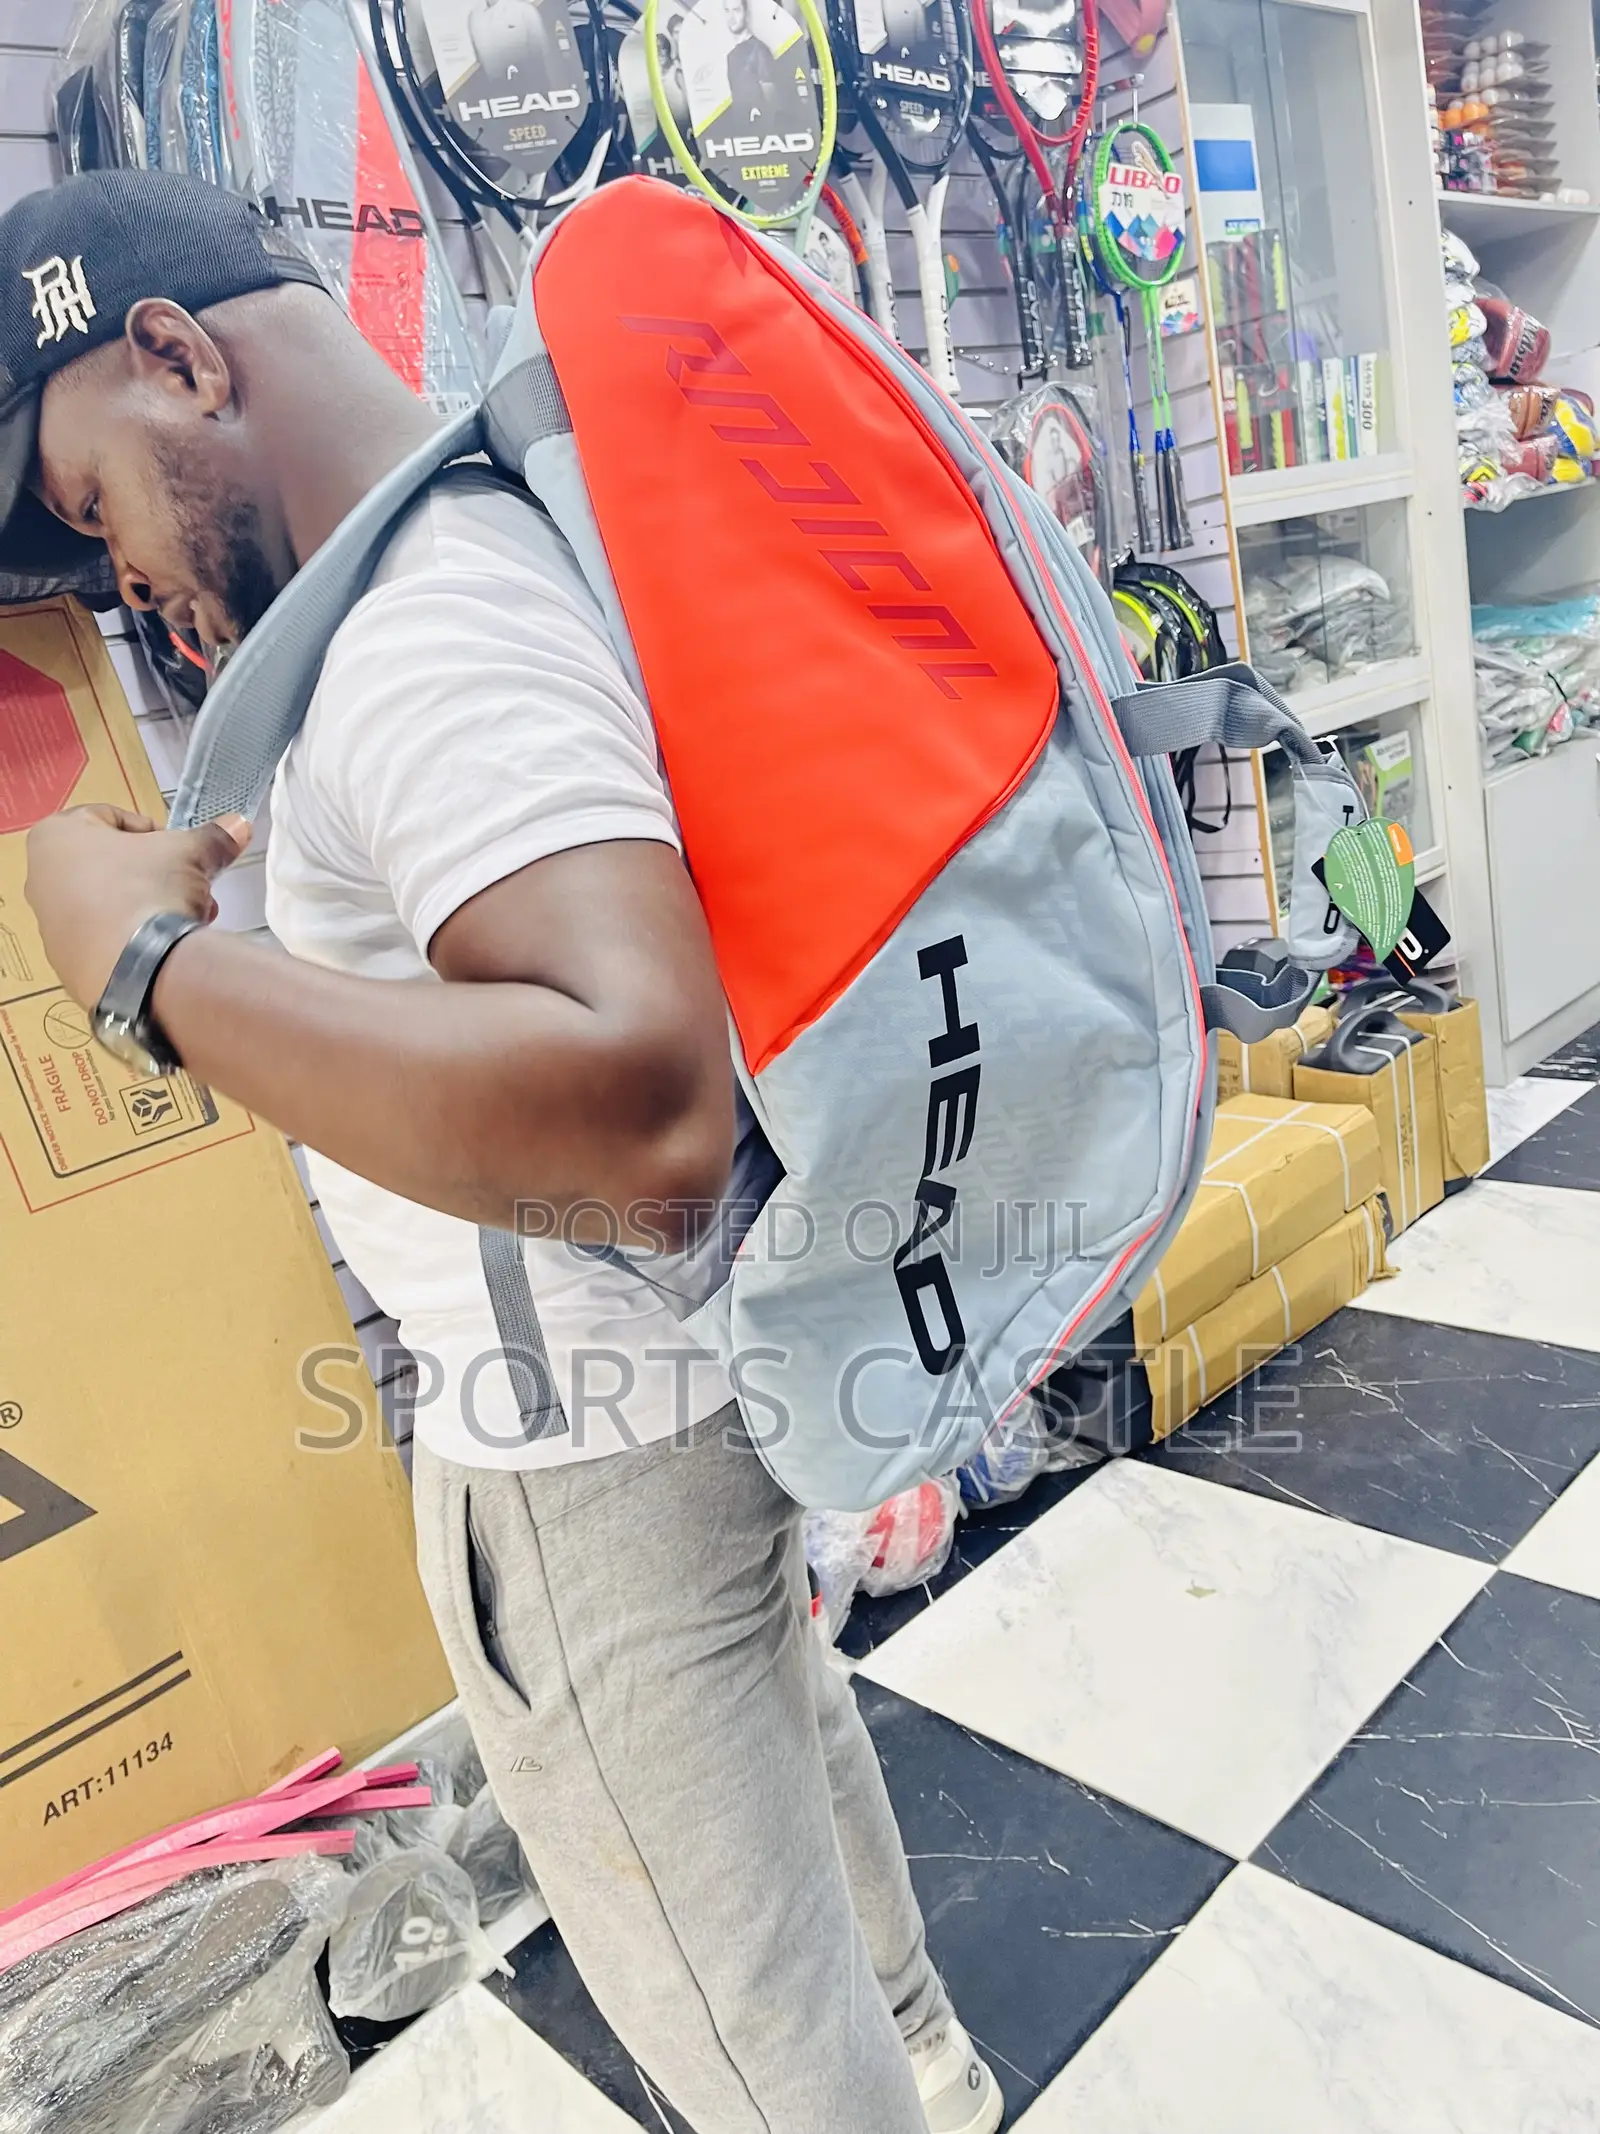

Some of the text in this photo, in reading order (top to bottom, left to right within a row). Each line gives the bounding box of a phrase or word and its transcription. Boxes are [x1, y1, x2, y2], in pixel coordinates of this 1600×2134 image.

[872, 60, 951, 93] HEAD
[458, 89, 580, 121] HEAD
[508, 125, 547, 141] SPEED
[704, 132, 814, 159] HEAD
[741, 164, 790, 180] EXTREME
[264, 195, 428, 238] HEAD
[1362, 399, 1373, 430] 300
[38, 1053, 71, 1113] FRAGILE
[72, 1051, 108, 1126] DO NOT DROP
[894, 934, 981, 1376] HEAD
[44, 1731, 173, 1827] ART:11134
